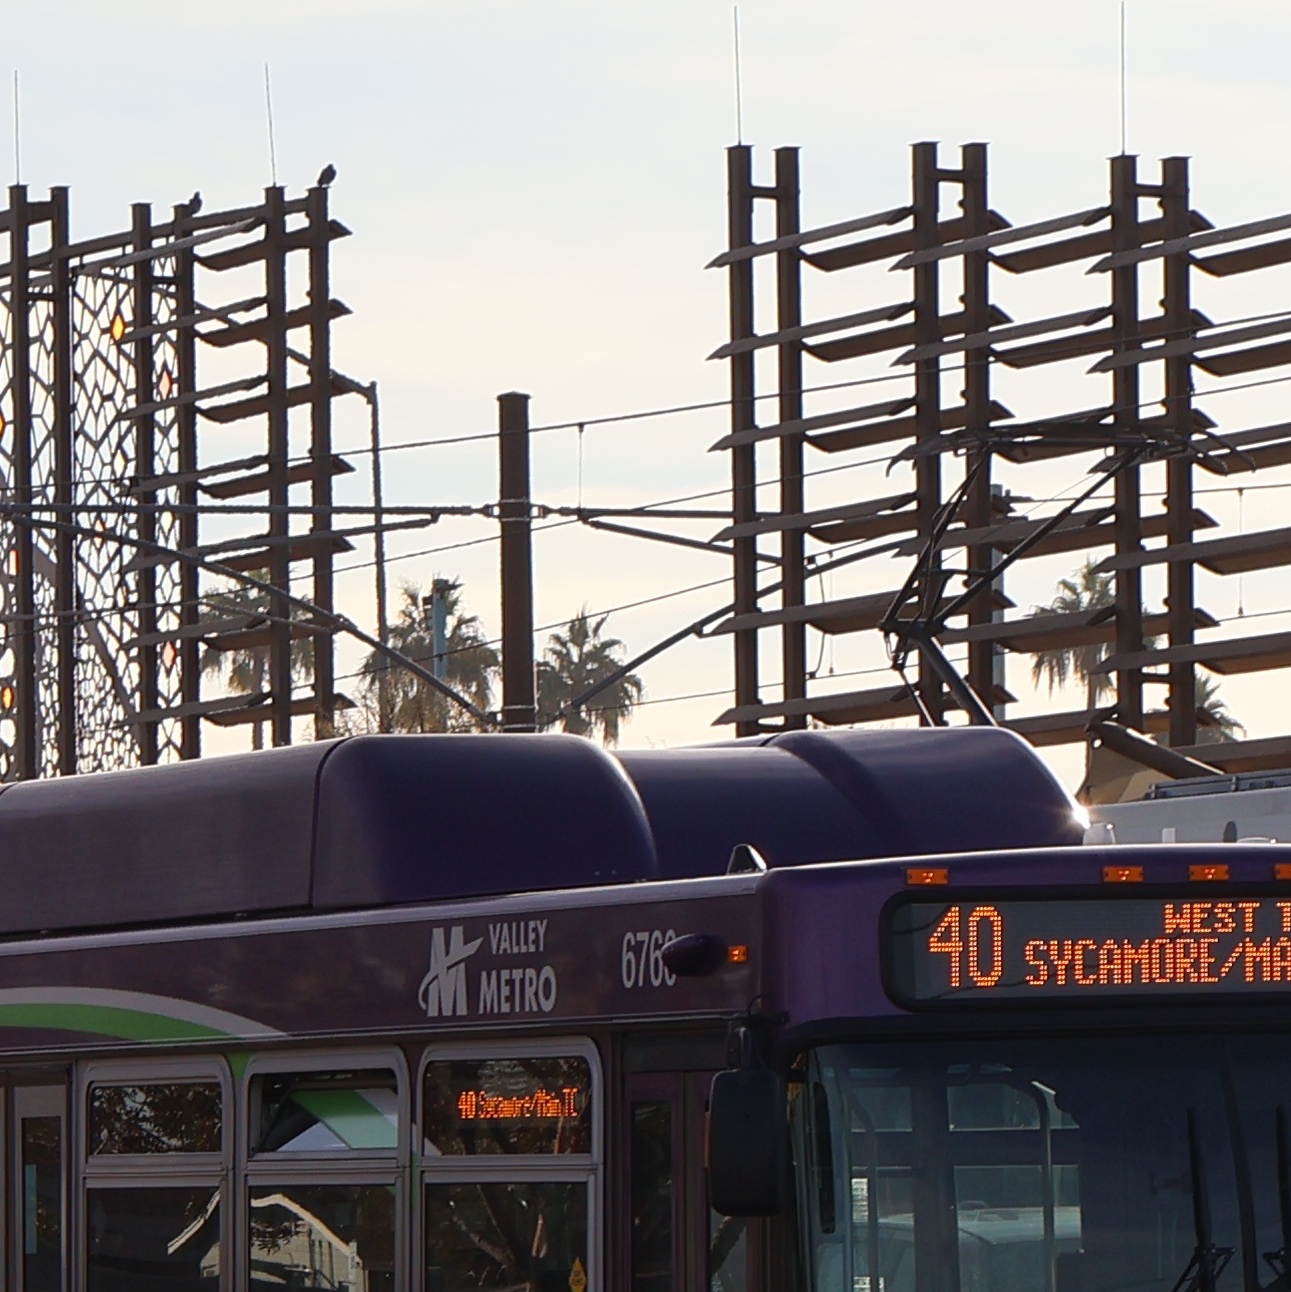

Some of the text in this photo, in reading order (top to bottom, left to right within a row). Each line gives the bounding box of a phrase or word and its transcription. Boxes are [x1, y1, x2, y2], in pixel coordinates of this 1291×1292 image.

[488, 919, 548, 956] VALLEY
[1163, 901, 1262, 935] WEST
[928, 904, 1004, 989] 40
[478, 965, 557, 1015] METRO
